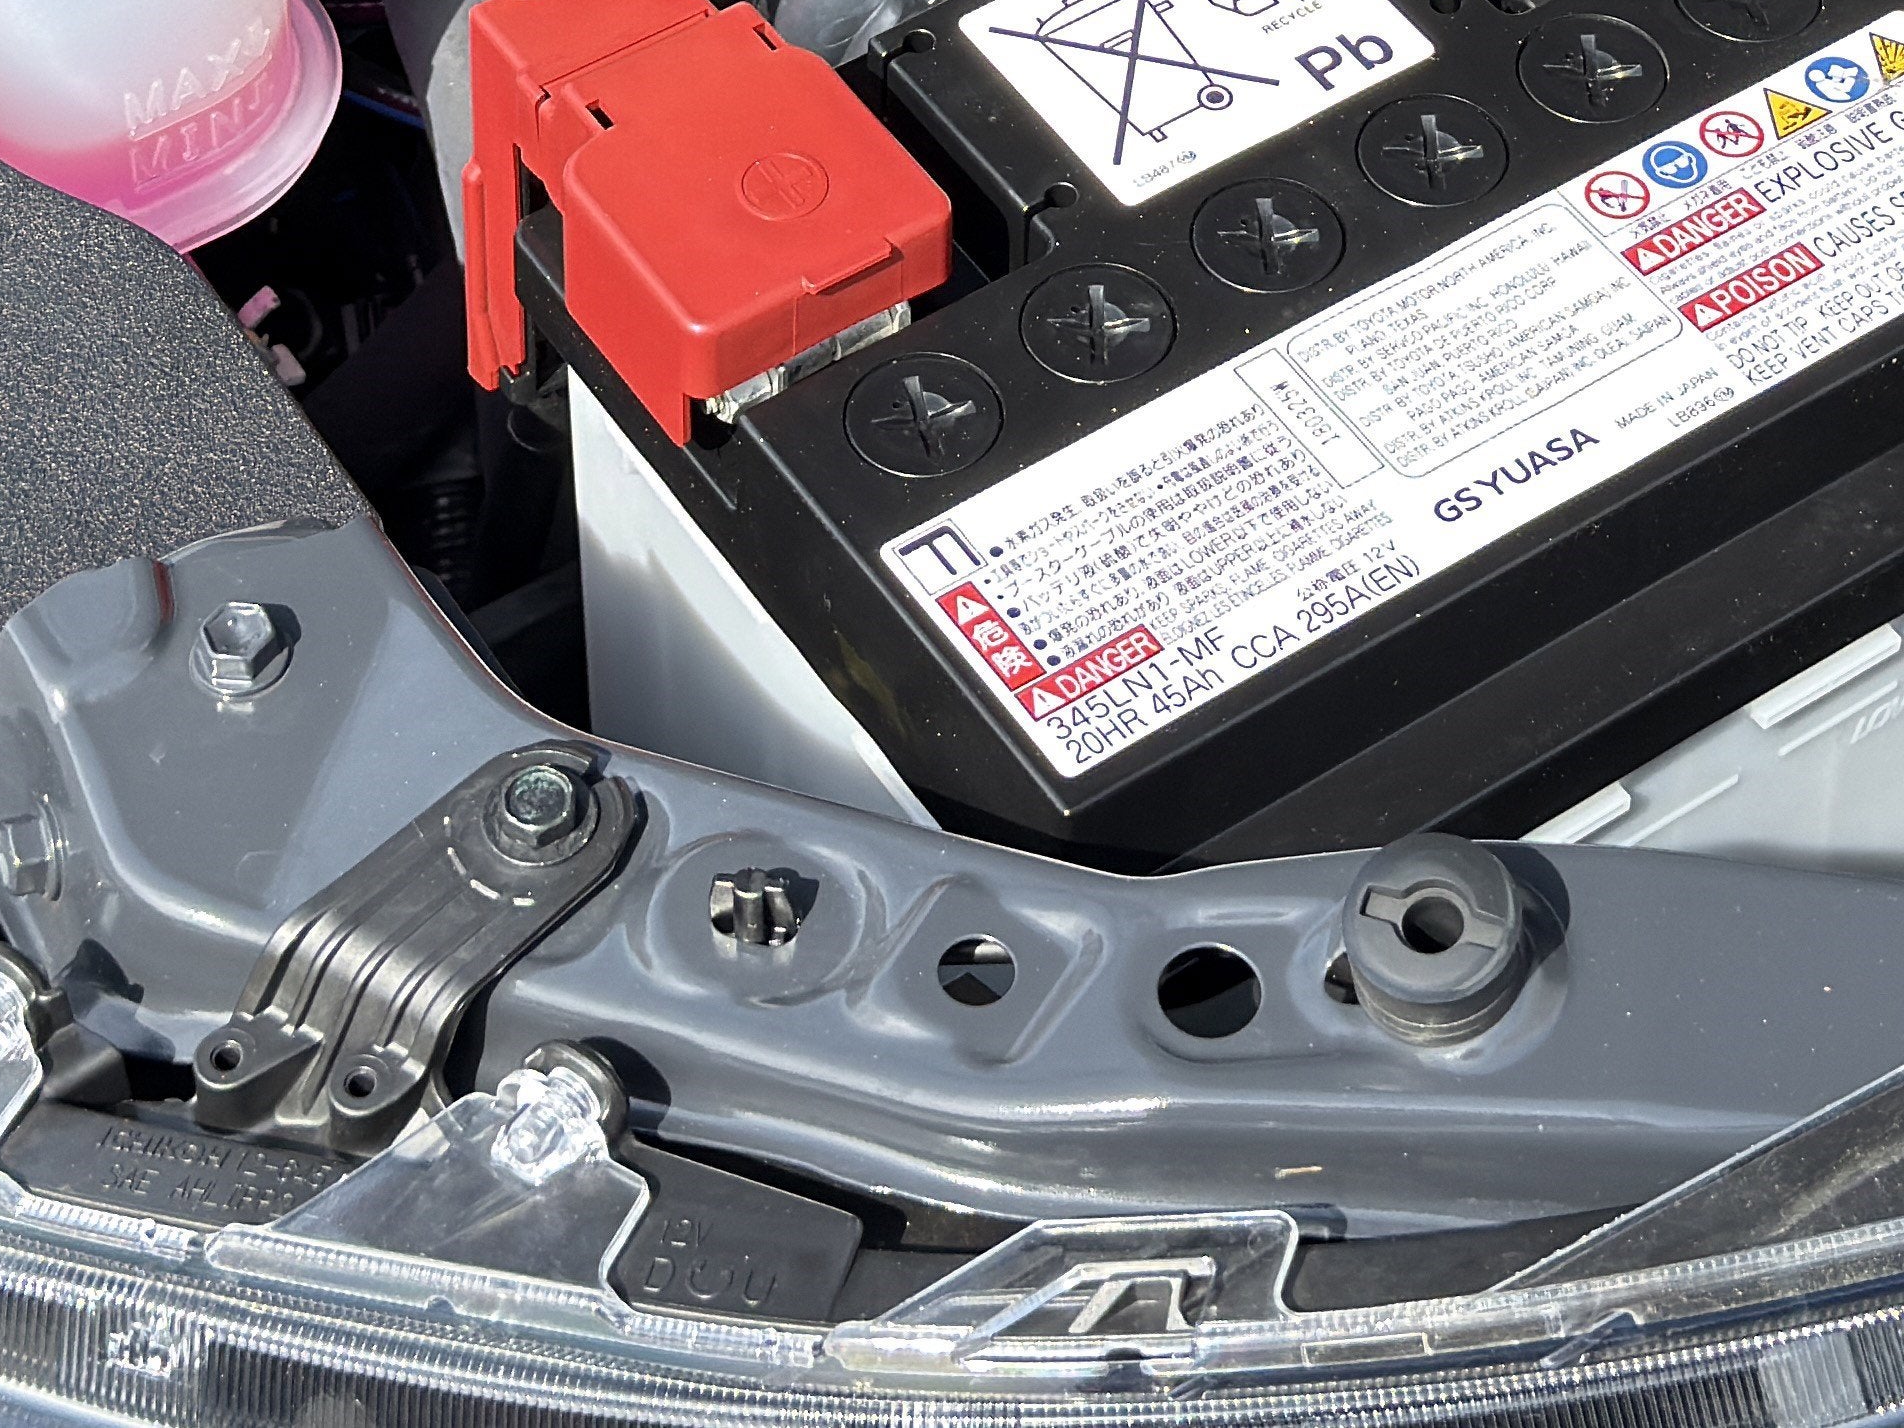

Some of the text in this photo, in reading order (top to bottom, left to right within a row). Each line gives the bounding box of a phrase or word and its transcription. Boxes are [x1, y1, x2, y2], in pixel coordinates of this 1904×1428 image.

[1294, 33, 1394, 92] Pb
[1648, 189, 1763, 260] DANGER
[1754, 122, 1892, 202] EXPLOSIVE
[1707, 246, 1819, 316] POISON
[1813, 205, 1895, 257] CAUSES
[1349, 306, 1397, 333] TOYOTA
[1395, 284, 1439, 310] MOTOR
[1436, 263, 1476, 290] NORTH
[1387, 308, 1428, 331] TEXAS
[1726, 347, 1755, 369] DO
[1750, 328, 1784, 354] NOT
[1782, 316, 1807, 336] TIP
[1818, 291, 1853, 318] KEEP
[1854, 272, 1881, 298] OUT
[1386, 344, 1433, 370] TOYOTA
[1478, 347, 1537, 382] AMERICAN
[1745, 352, 1787, 385] KEEP
[1789, 325, 1836, 358] VENT
[1837, 299, 1888, 333] CAPS
[1411, 371, 1459, 395] TOYOTA
[1614, 367, 1718, 428] MADE IN JAPAN
[1433, 428, 1599, 522] GS YUASA
[1362, 539, 1395, 562] 12V
[966, 614, 1035, 680] 危険
[1052, 629, 1160, 700] DANGER
[1065, 555, 1419, 763] 20HR 45Ah CCA 295A(EN)
[1047, 626, 1223, 739] 345LN1-MF
